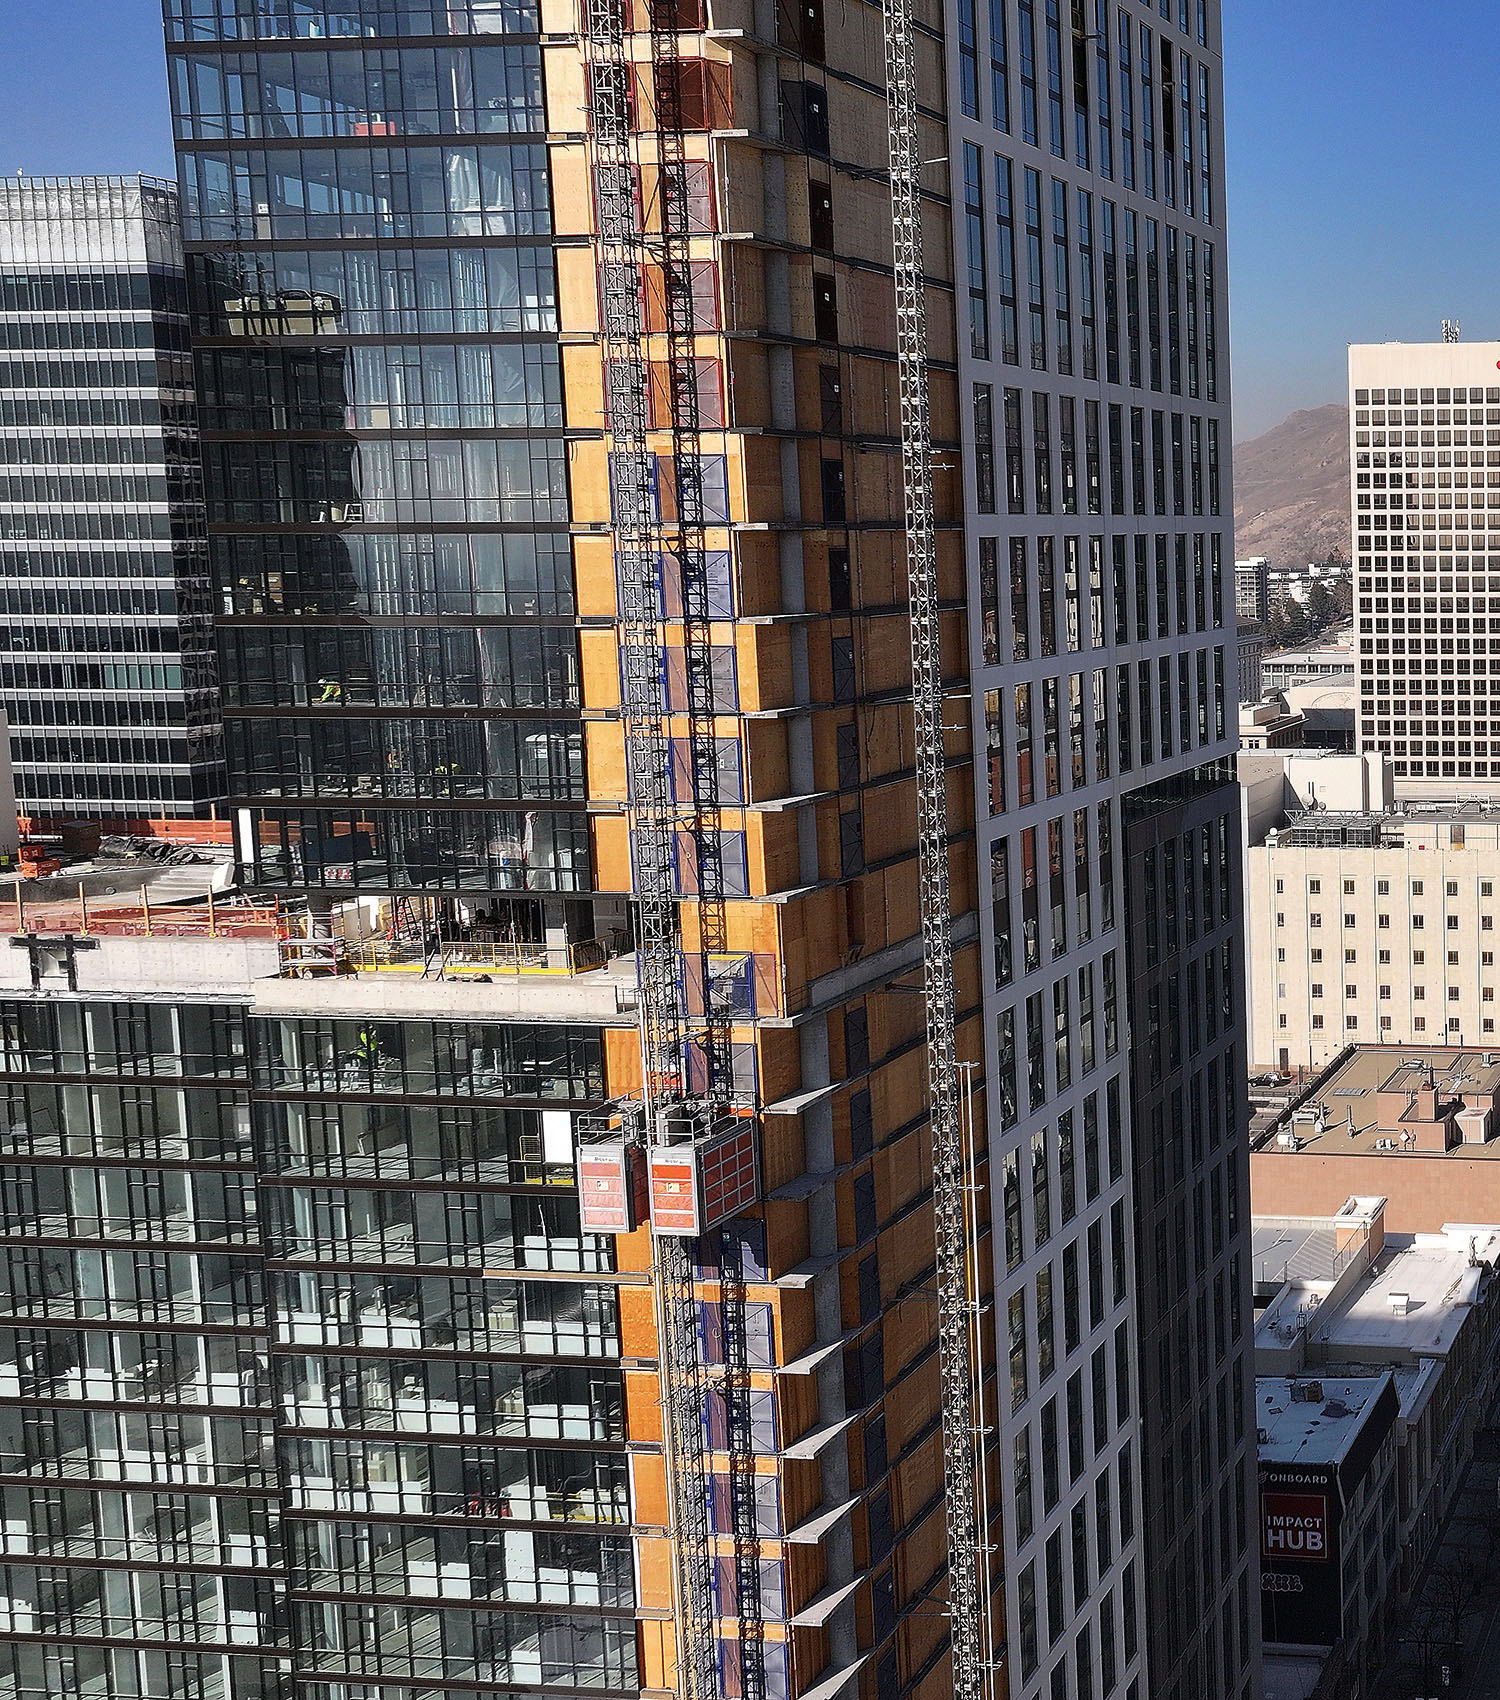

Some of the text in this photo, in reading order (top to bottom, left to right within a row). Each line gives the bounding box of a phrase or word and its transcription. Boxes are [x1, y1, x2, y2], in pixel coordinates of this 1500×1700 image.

[1269, 1473, 1328, 1484] ONBOARD
[1267, 1515, 1322, 1529] IMPACT
[1267, 1529, 1323, 1550] HUB
